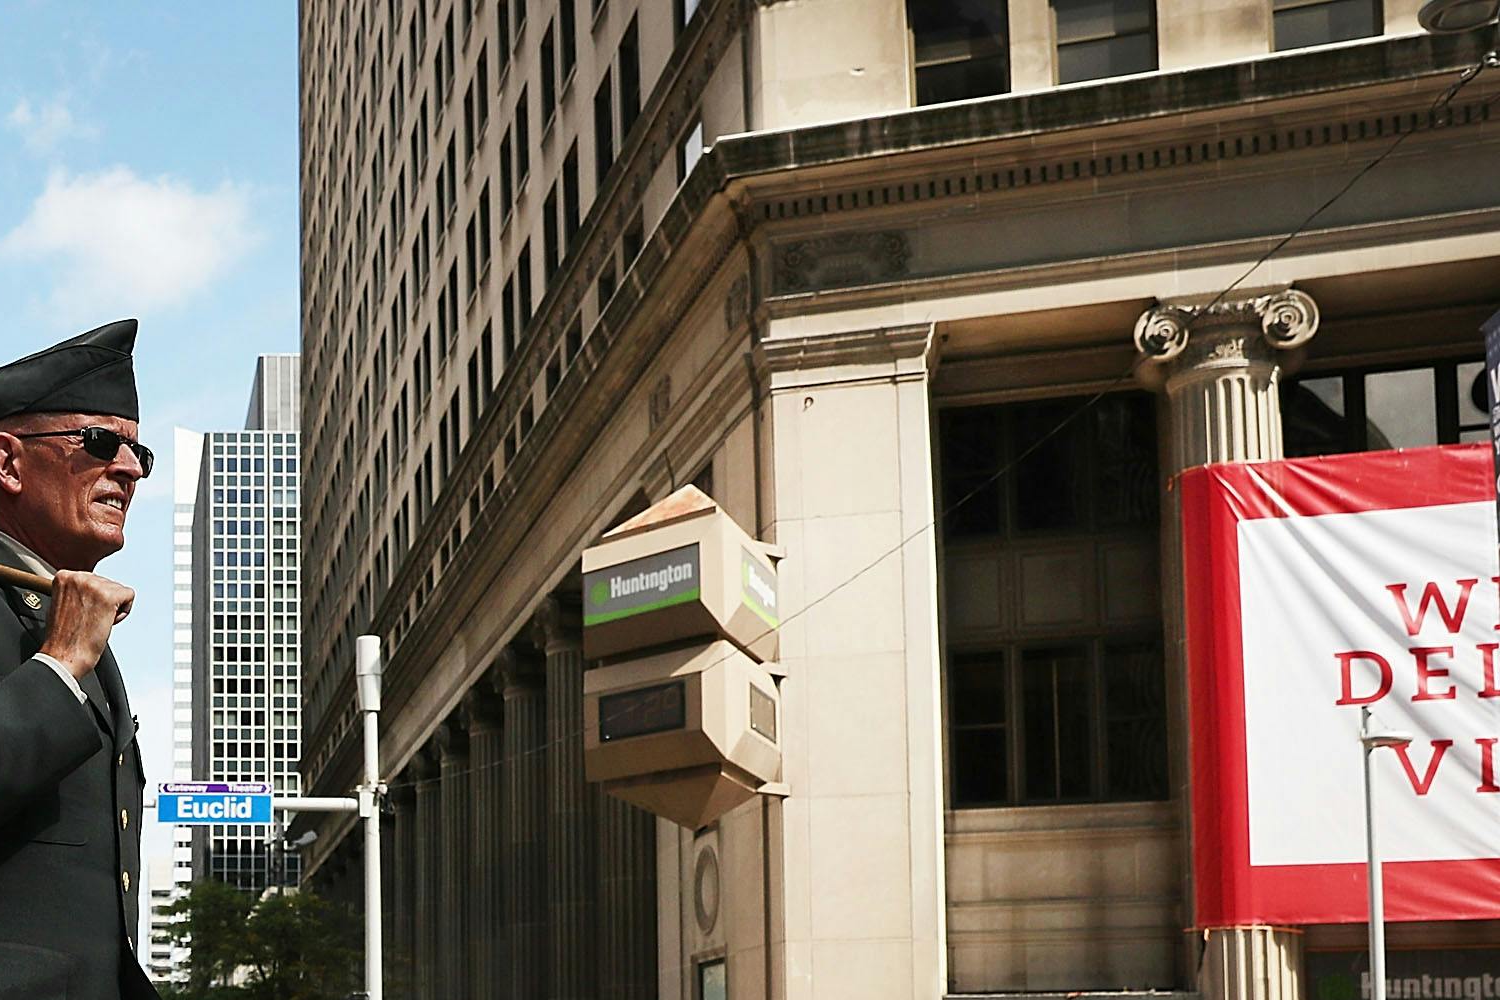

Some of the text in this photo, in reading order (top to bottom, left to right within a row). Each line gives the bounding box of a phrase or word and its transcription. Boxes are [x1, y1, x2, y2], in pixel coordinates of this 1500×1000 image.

[610, 562, 692, 599] Huntington
[1385, 576, 1500, 636] W
[166, 783, 209, 793] Gateway
[177, 796, 252, 819] Euclid
